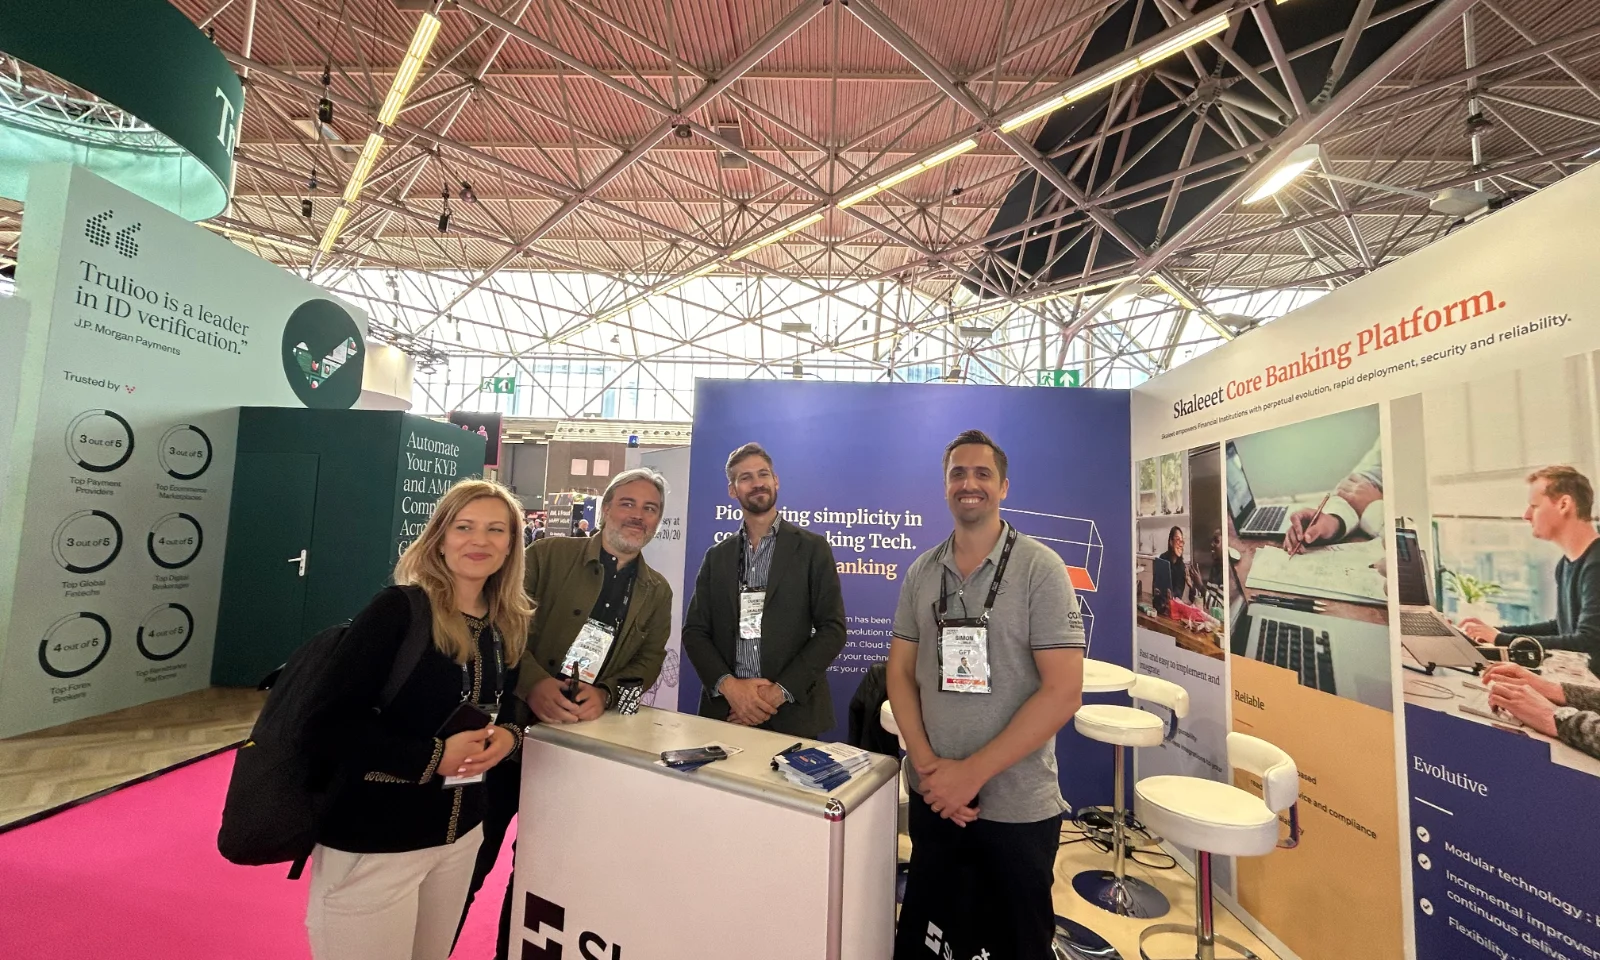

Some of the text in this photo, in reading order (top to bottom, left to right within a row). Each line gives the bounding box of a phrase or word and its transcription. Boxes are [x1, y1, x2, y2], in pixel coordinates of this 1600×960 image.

[76, 286, 98, 309] in
[105, 295, 131, 319] ID
[80, 260, 249, 337] Trulioo is a leader
[74, 320, 181, 356] J.P. Morgan Payments
[1173, 289, 1507, 419] Skaleeet Core Banking Platform.
[64, 370, 120, 392] Trusted by
[1175, 424, 1197, 436] empowers
[1197, 415, 1218, 429] Financial
[1219, 409, 1248, 423] Institutions
[1249, 405, 1262, 415] with
[1262, 394, 1294, 412] perpetual
[1295, 384, 1332, 401] evolution,
[1333, 376, 1355, 390] rapid
[1356, 358, 1419, 383] deployment,
[1420, 343, 1467, 365] security
[1469, 334, 1495, 350] and
[1499, 313, 1572, 342] reliability.
[79, 434, 122, 448] 3 out of 5
[406, 431, 460, 458] Automate
[169, 447, 176, 455] 3
[197, 450, 203, 458] 5
[406, 452, 457, 476] Your KYB
[70, 477, 121, 489] Top Payment
[75, 487, 114, 496] Providers
[156, 484, 168, 492] Top
[403, 477, 426, 493] and
[813, 506, 901, 530] simplicity
[904, 510, 922, 527] in
[66, 538, 75, 547] 3
[92, 539, 102, 547] of
[102, 538, 111, 546] 5
[158, 537, 165, 545] 4
[187, 537, 194, 545] 5
[825, 530, 865, 553] king
[869, 534, 917, 550] Tech.
[155, 574, 168, 583] Top
[836, 559, 898, 580] anking
[62, 580, 106, 590] Top Global
[64, 589, 101, 598] Fintechs
[870, 616, 891, 624] been
[147, 627, 184, 638] 4 out of 5
[846, 628, 883, 637] evolution
[53, 638, 99, 653] 4 out of 5
[859, 641, 891, 649] Cloud-b
[840, 666, 858, 674] your
[1139, 648, 1149, 659] Fast
[1149, 653, 1158, 663] and
[1159, 656, 1169, 668] easy
[1176, 661, 1207, 681] implement
[1208, 675, 1220, 686] and
[51, 687, 67, 696] Top
[1234, 689, 1265, 711] Reliable
[1413, 755, 1488, 797] Evolutive
[1313, 801, 1328, 813] and
[1329, 808, 1377, 839] compliance
[1444, 841, 1495, 874] Modular
[1498, 868, 1582, 919] technology
[1446, 870, 1523, 919] Incremental
[1447, 890, 1571, 960] continuous delive
[1449, 916, 1508, 960] Flexibility
